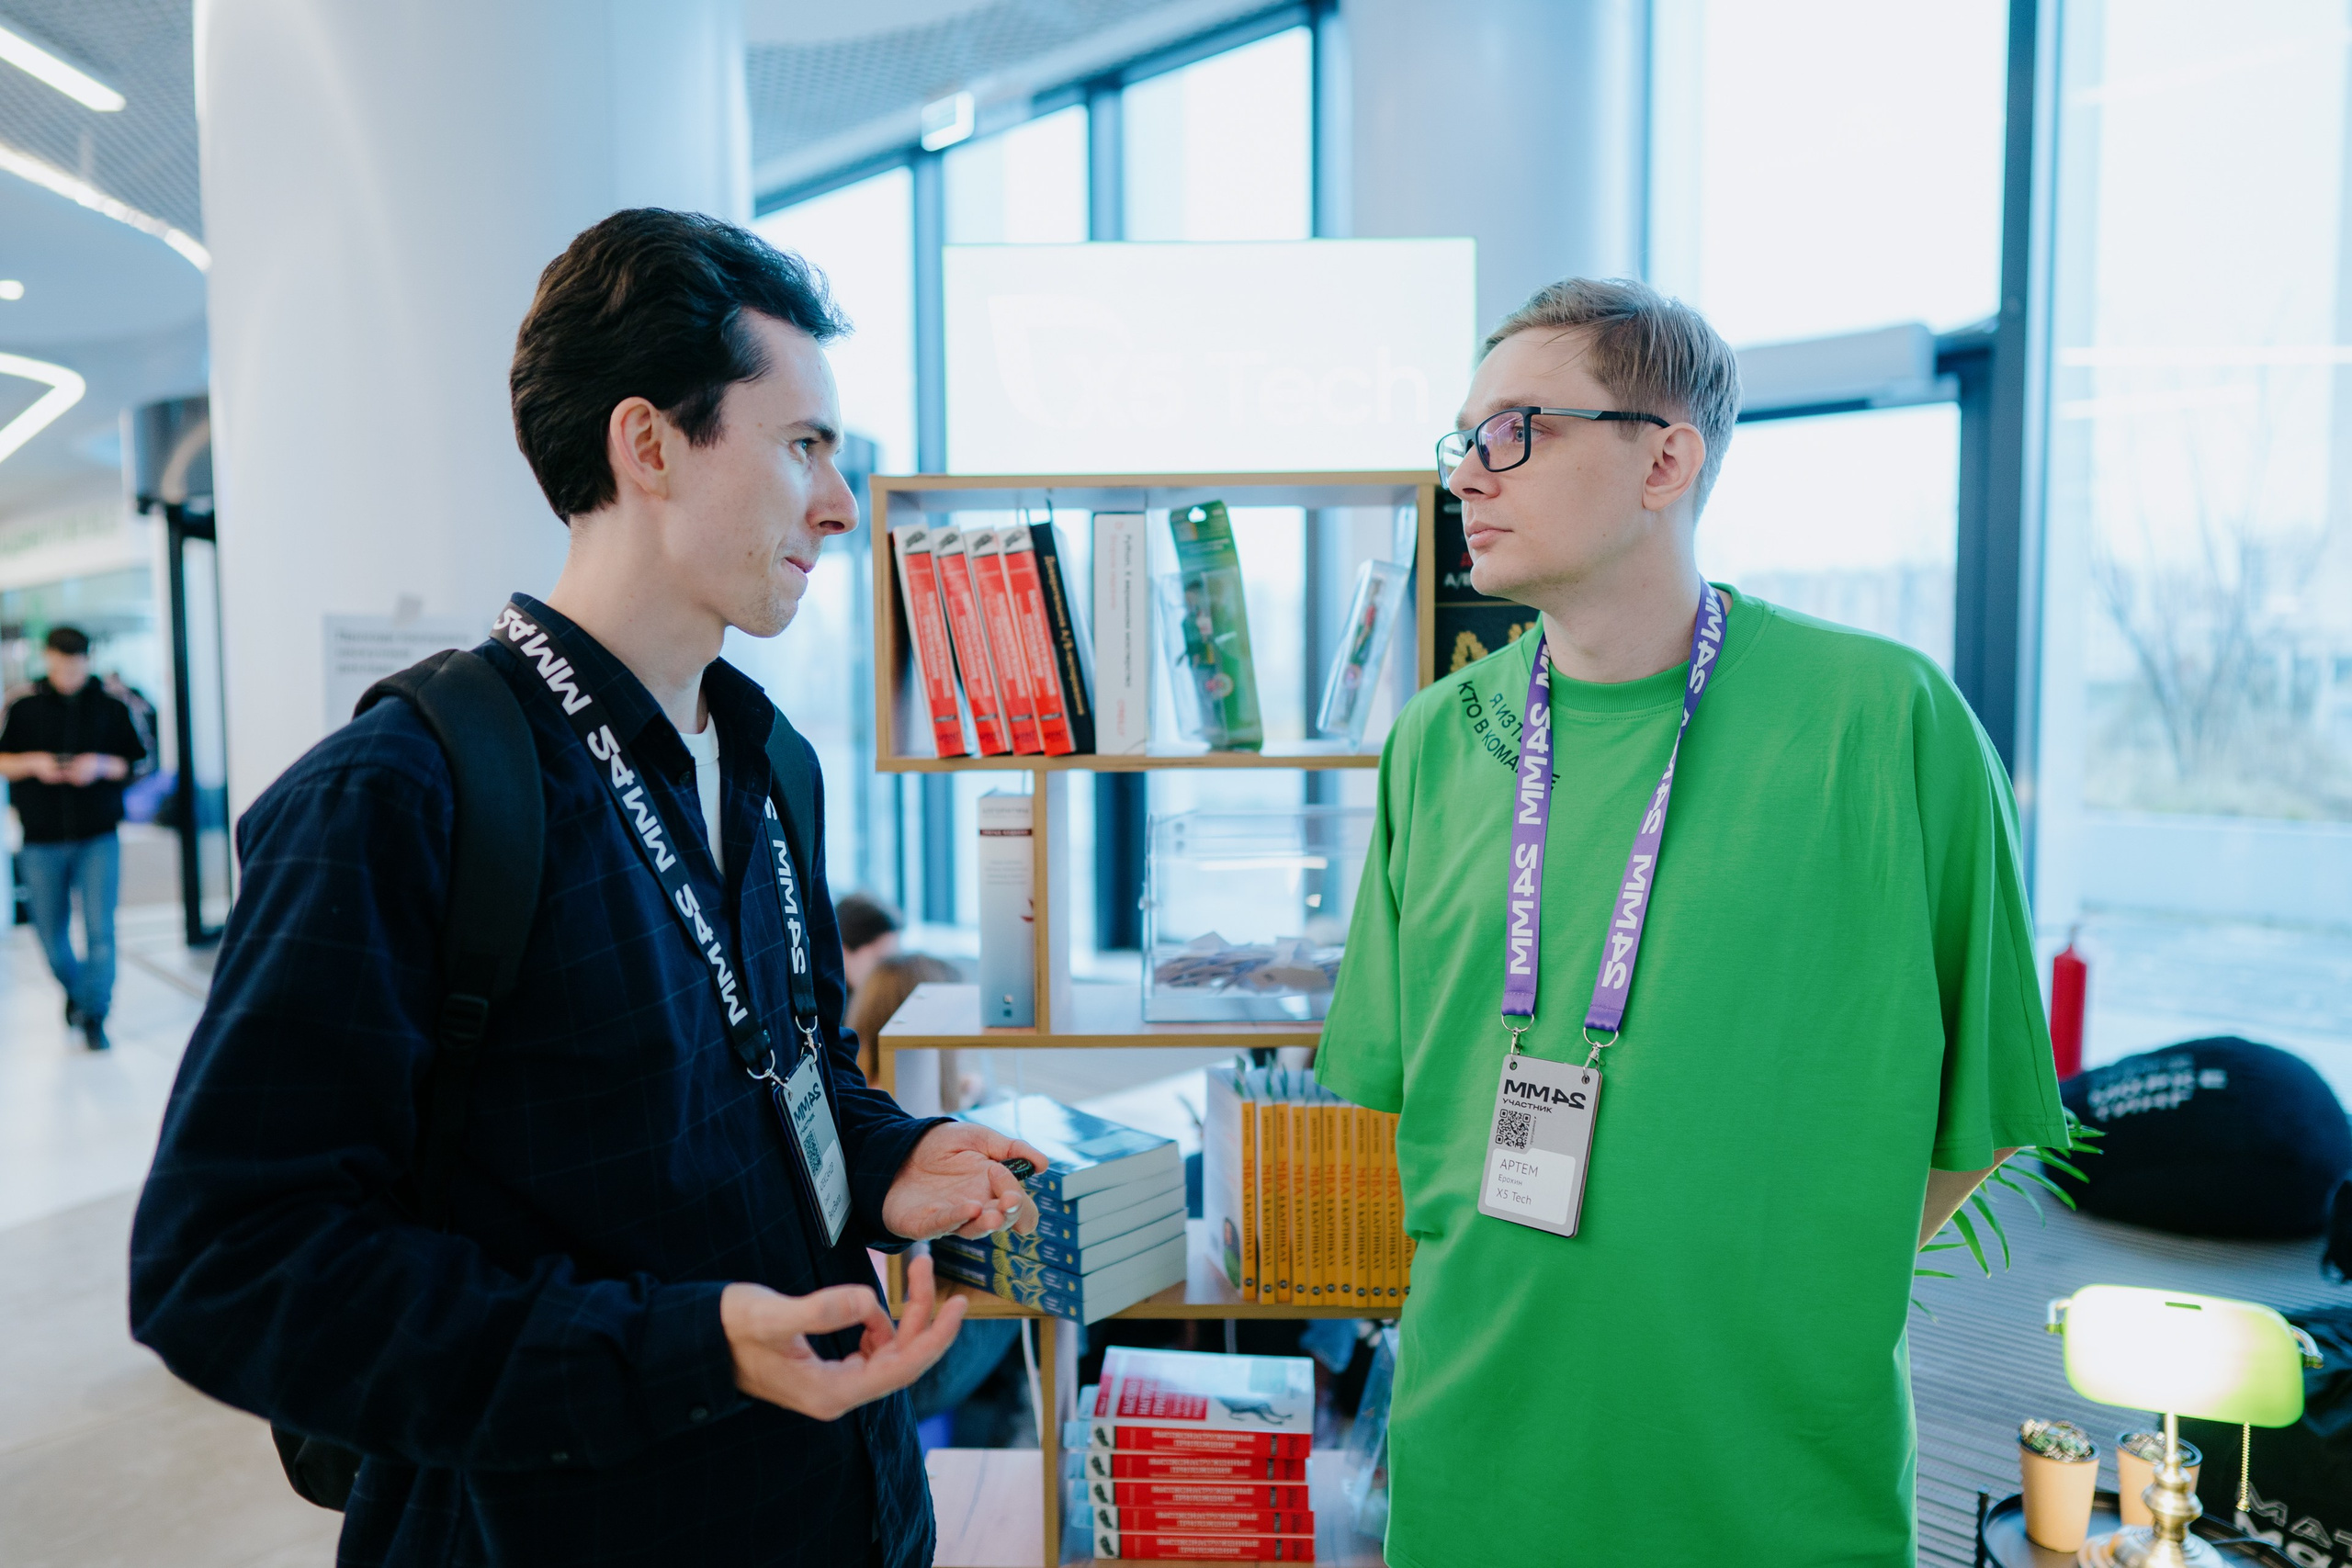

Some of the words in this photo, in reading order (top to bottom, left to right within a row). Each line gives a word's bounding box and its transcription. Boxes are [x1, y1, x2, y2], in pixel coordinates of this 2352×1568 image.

[1204, 345, 1430, 427] Tech
[1502, 1098, 1553, 1113] УЧАСТНИК
[1499, 1158, 1539, 1178] АРТЕМ
[1498, 1173, 1523, 1187] Ерохин
[1496, 1188, 1509, 1199] X5
[1511, 1190, 1532, 1205] Tech
